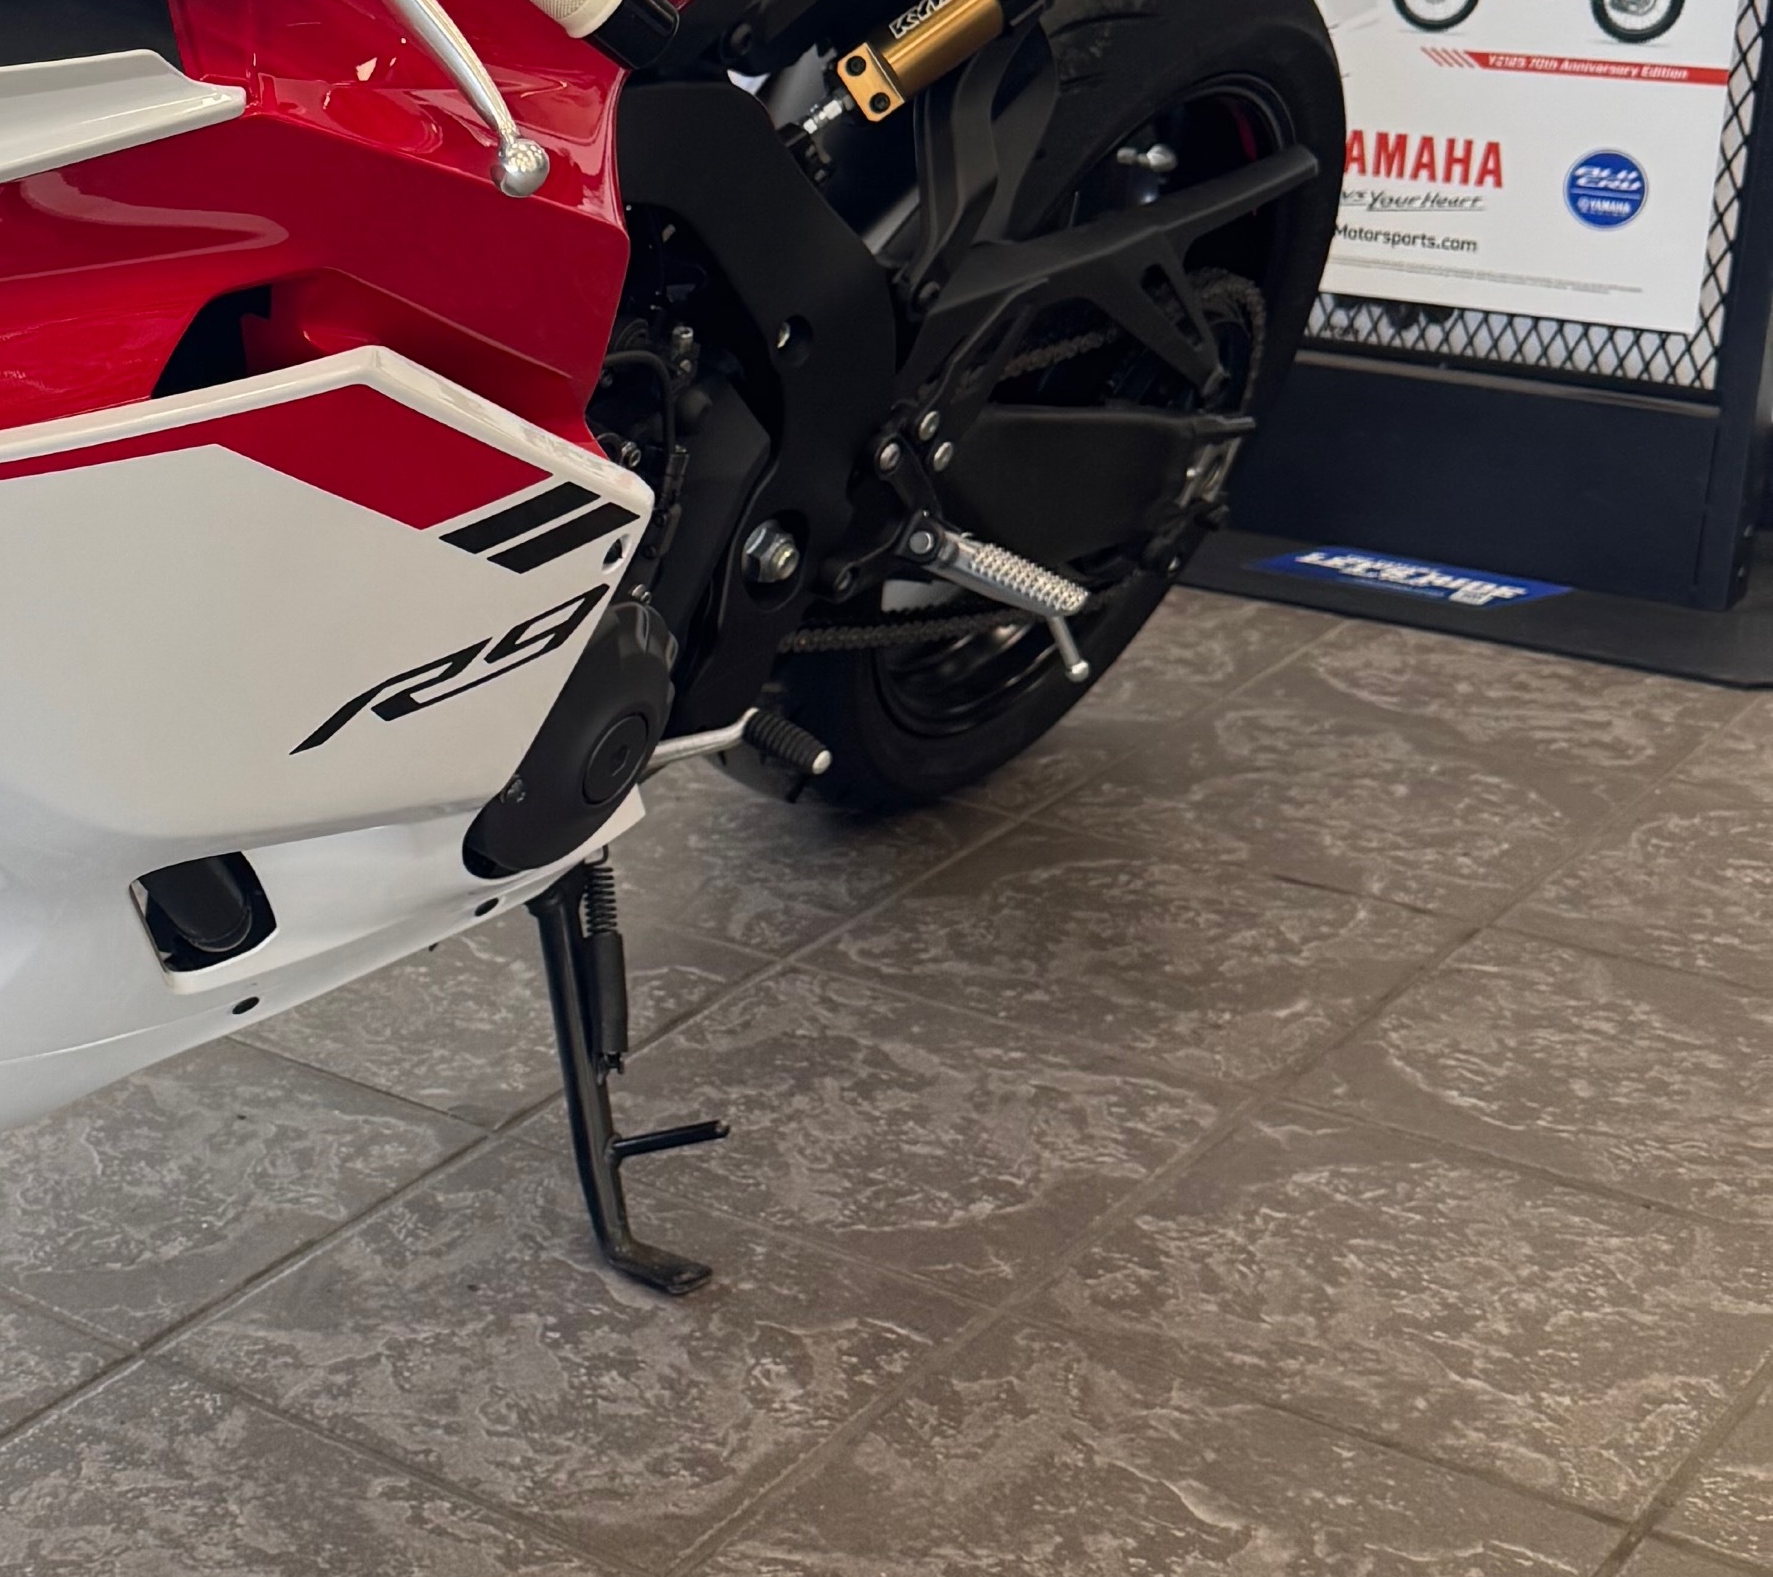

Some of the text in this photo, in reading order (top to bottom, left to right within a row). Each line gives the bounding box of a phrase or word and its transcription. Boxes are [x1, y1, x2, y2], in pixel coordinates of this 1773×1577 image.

[1528, 55, 1559, 70] 70th
[1559, 57, 1639, 77] Anniversary
[1640, 66, 1688, 80] Edition
[289, 583, 610, 755] R9
